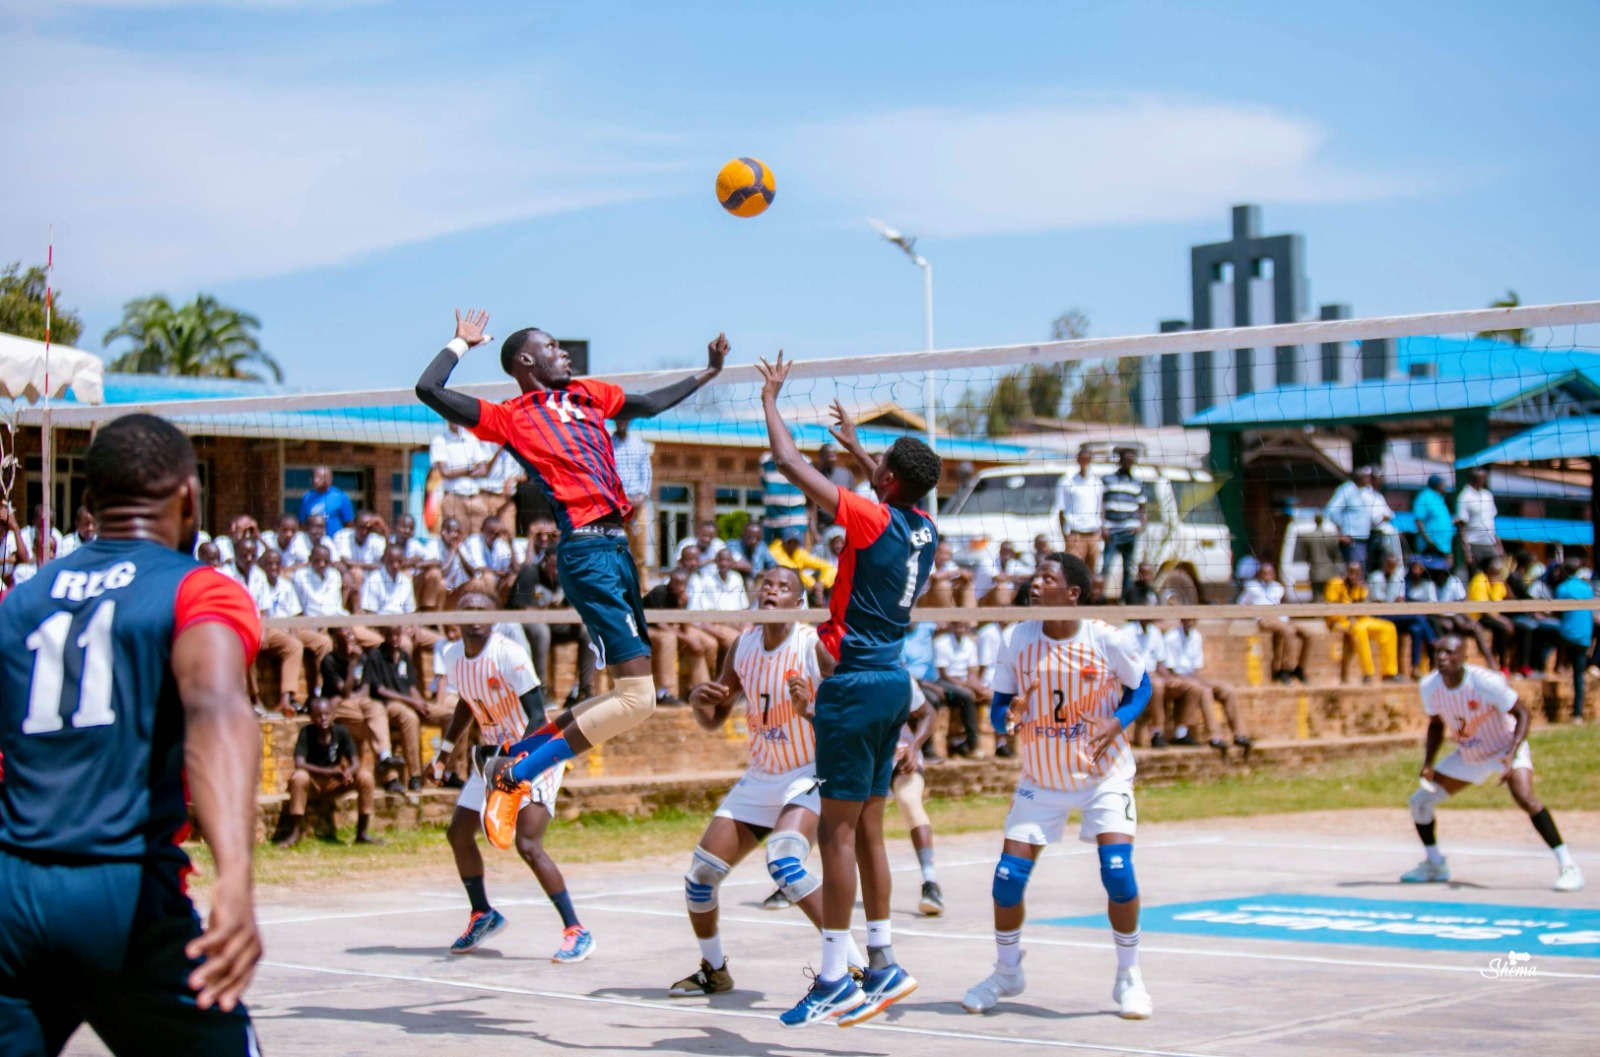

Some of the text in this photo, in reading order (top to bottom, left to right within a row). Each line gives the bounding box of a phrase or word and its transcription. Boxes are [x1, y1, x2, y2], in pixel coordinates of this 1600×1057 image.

[899, 550, 921, 607] 1
[22, 600, 115, 734] 11
[760, 693, 770, 725] 7
[1053, 690, 1066, 723] 2
